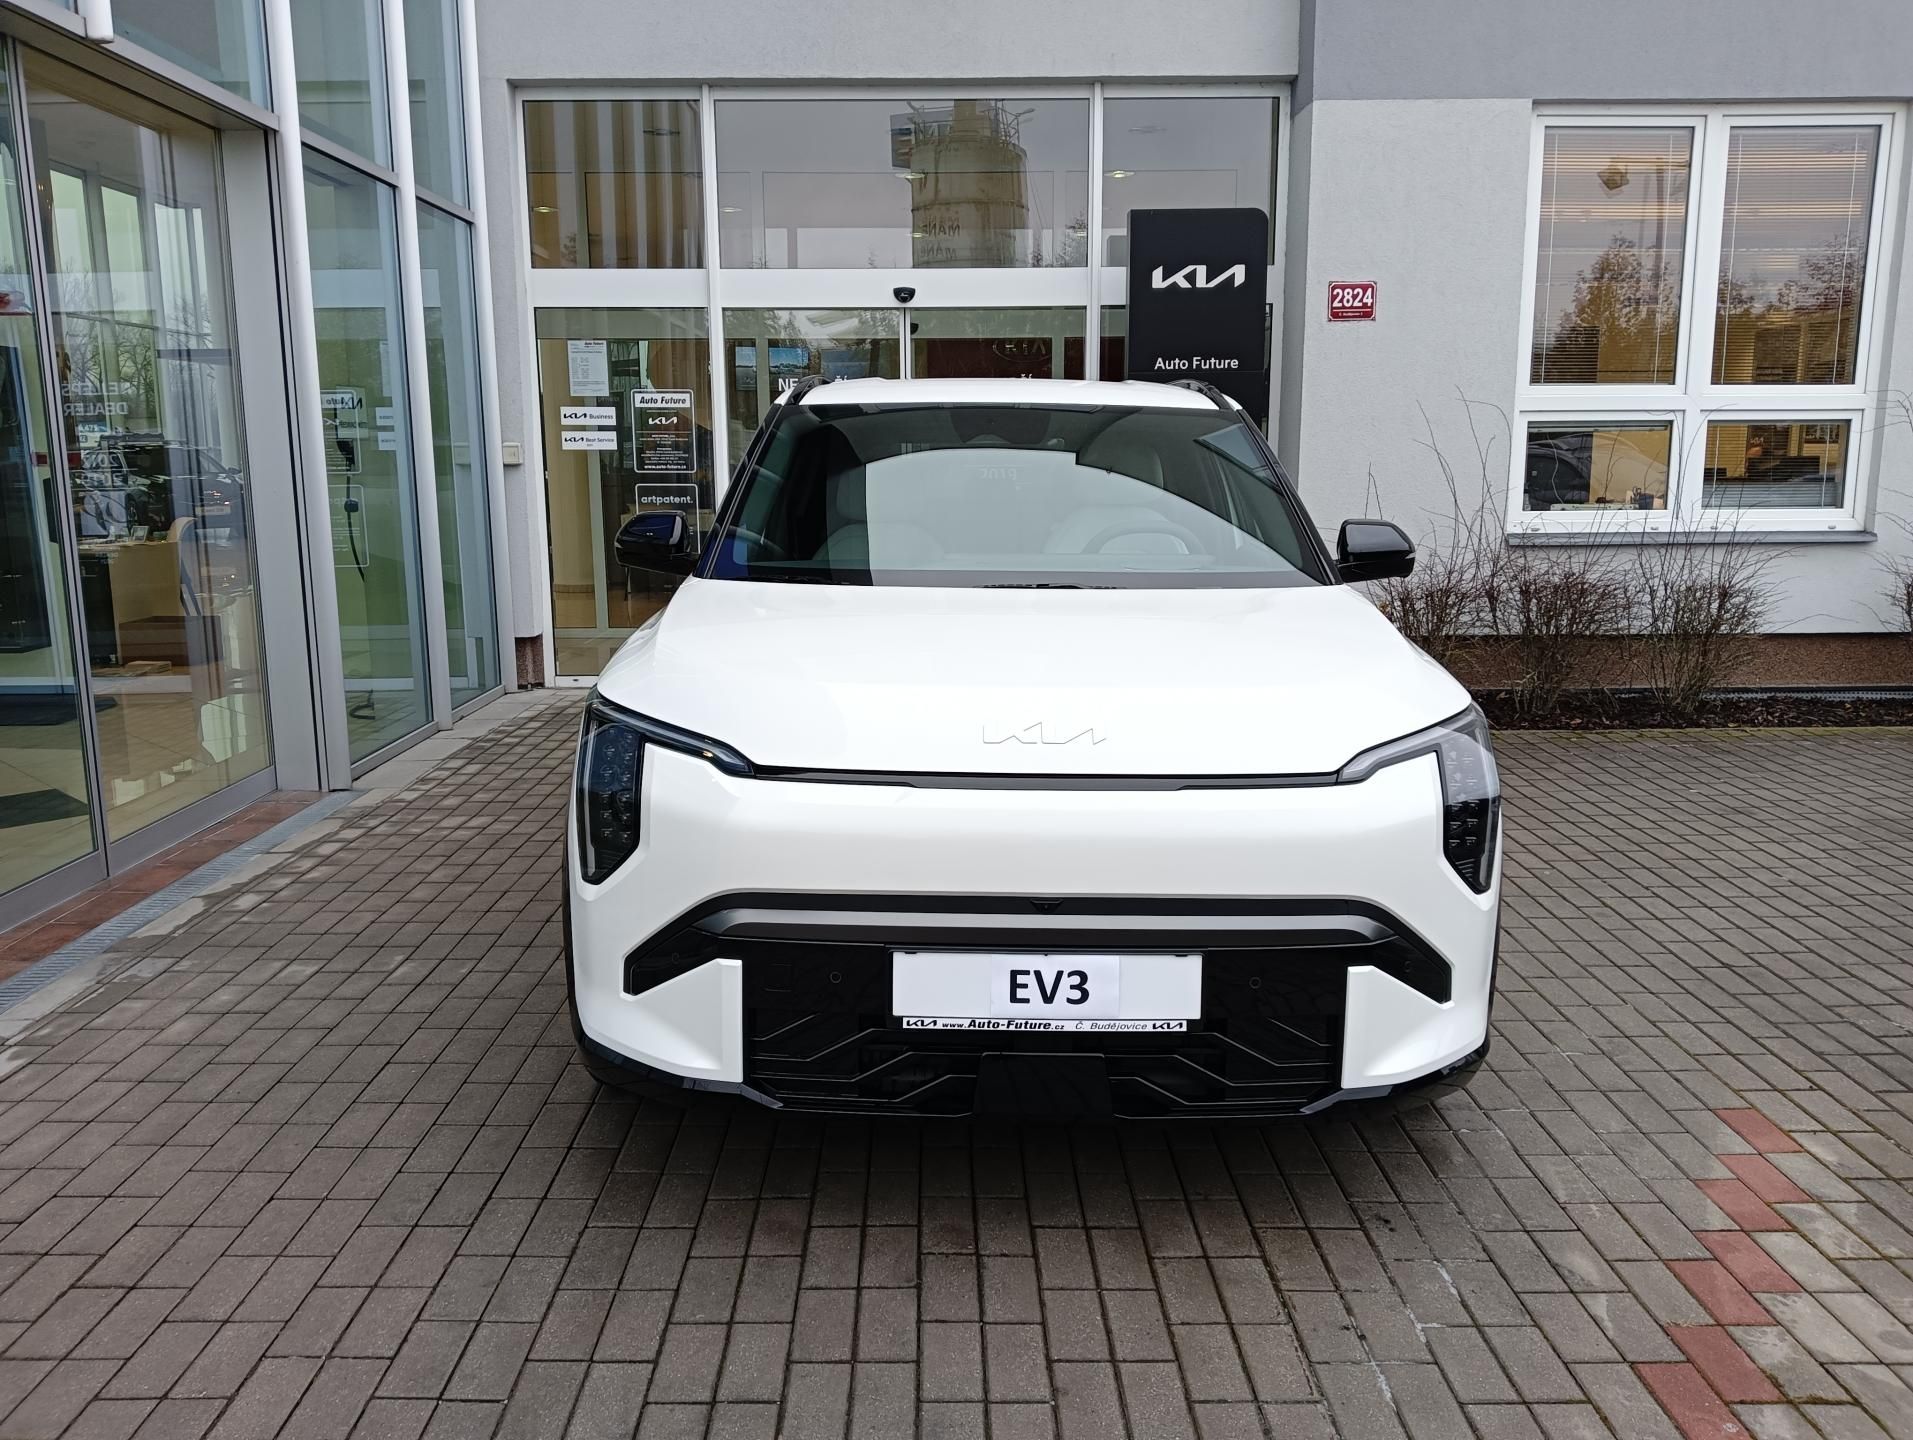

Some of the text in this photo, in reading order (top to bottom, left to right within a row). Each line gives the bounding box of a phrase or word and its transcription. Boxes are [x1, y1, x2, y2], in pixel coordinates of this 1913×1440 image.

[1151, 264, 1246, 289] KIA
[1332, 287, 1373, 307] 2824
[1154, 356, 1239, 370] Auto Future
[640, 396, 687, 405] Auto Future
[648, 416, 678, 425] KIA
[1009, 969, 1090, 1005] EV3
[906, 1019, 1184, 1031] KIA www.Auto-Future.cz Č. Budějovice KIA
